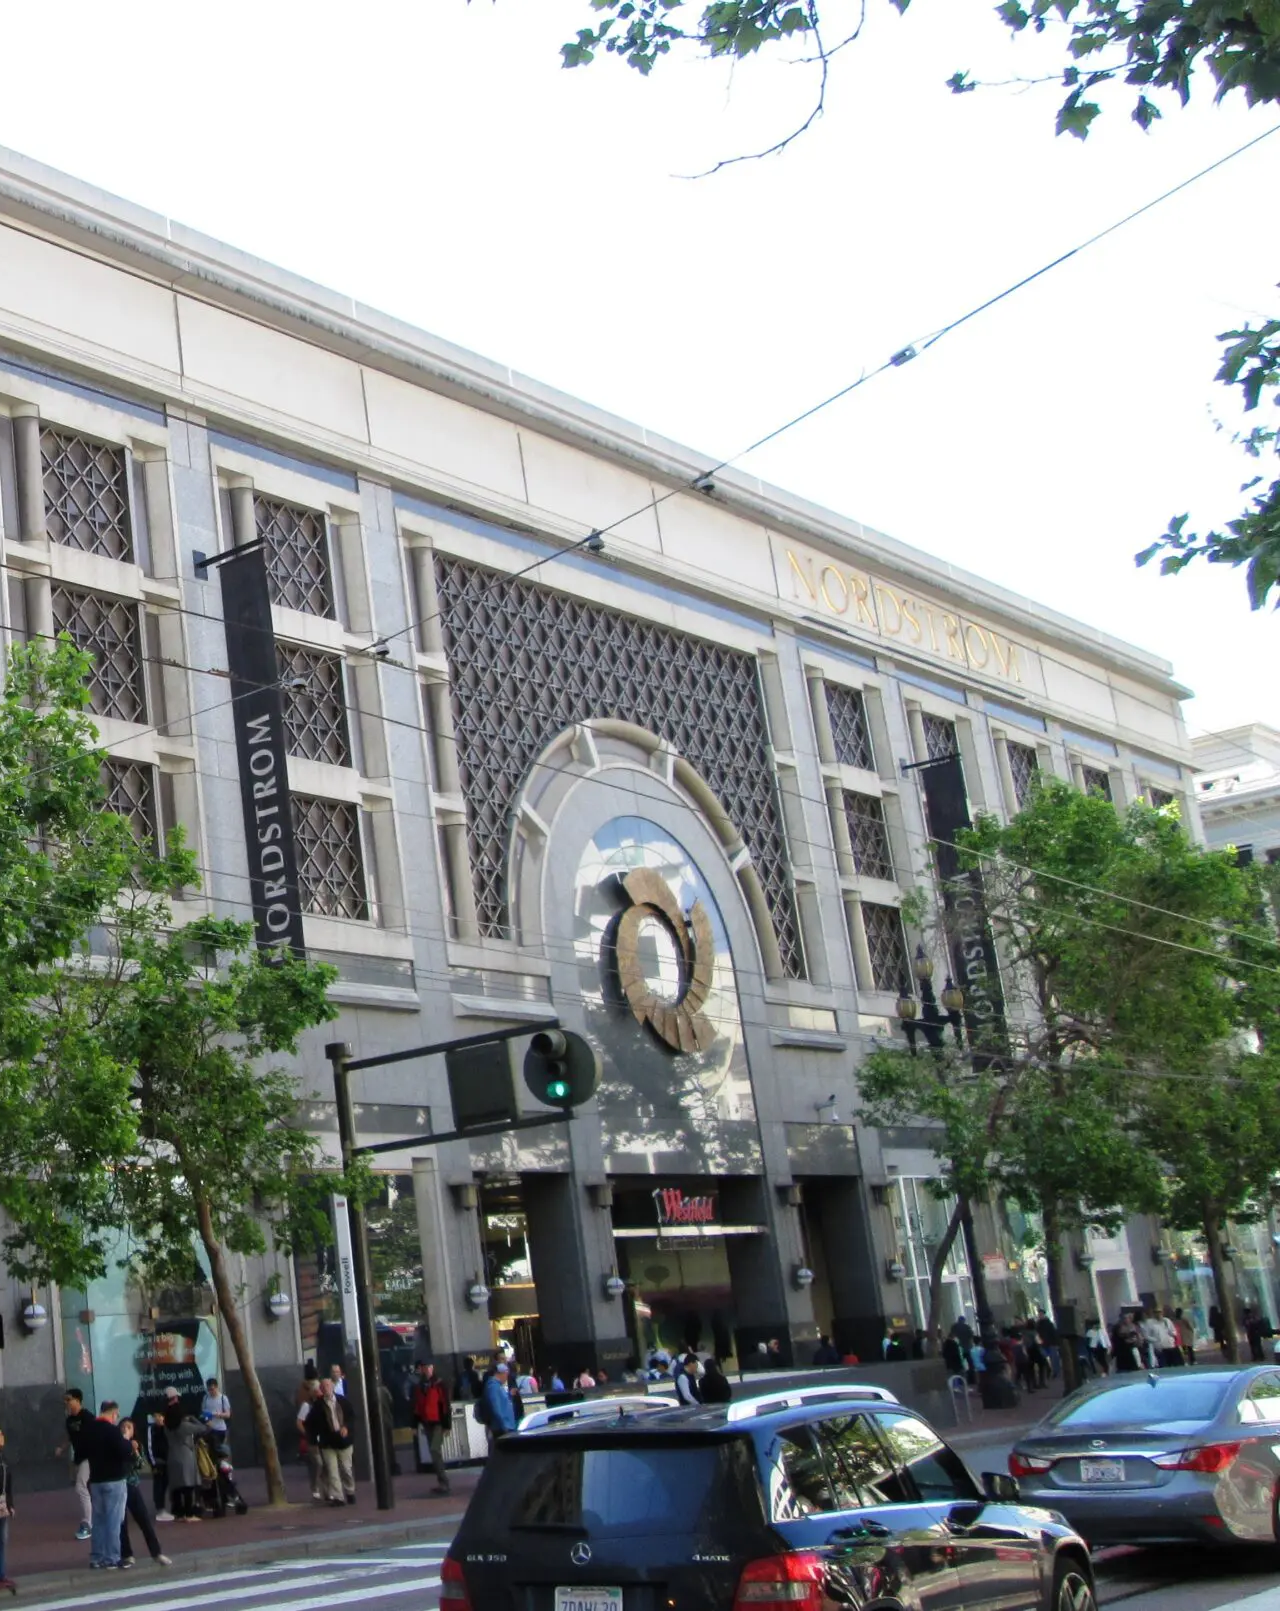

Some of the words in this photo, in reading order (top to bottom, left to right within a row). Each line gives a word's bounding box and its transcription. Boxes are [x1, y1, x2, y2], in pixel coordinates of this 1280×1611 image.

[787, 550, 1021, 683] NORDSTROM
[341, 1257, 353, 1294] Powell
[384, 1278, 414, 1291] EAGLE
